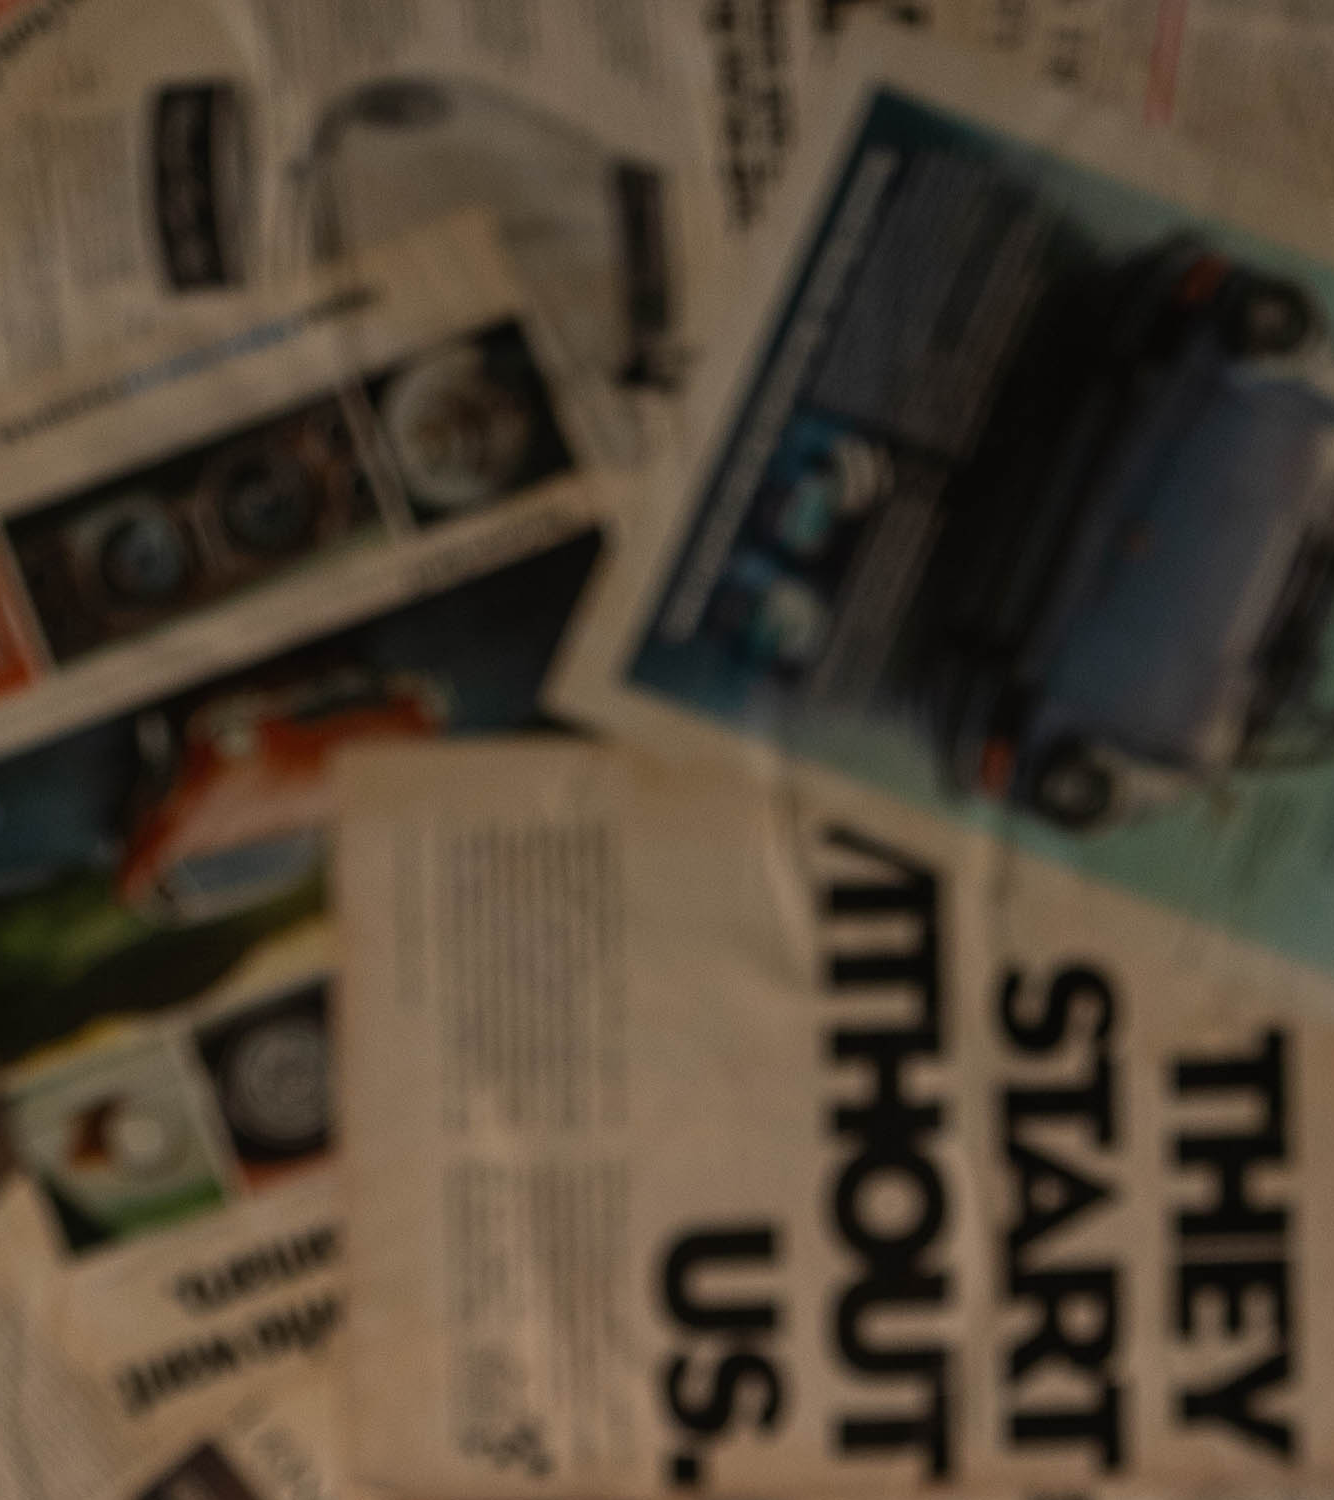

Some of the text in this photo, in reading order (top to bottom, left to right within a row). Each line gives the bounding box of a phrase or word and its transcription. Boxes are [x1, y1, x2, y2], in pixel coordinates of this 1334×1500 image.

[659, 1221, 786, 1492] US.
[998, 961, 1126, 1475] START
[1170, 1021, 1298, 1467] THEY
